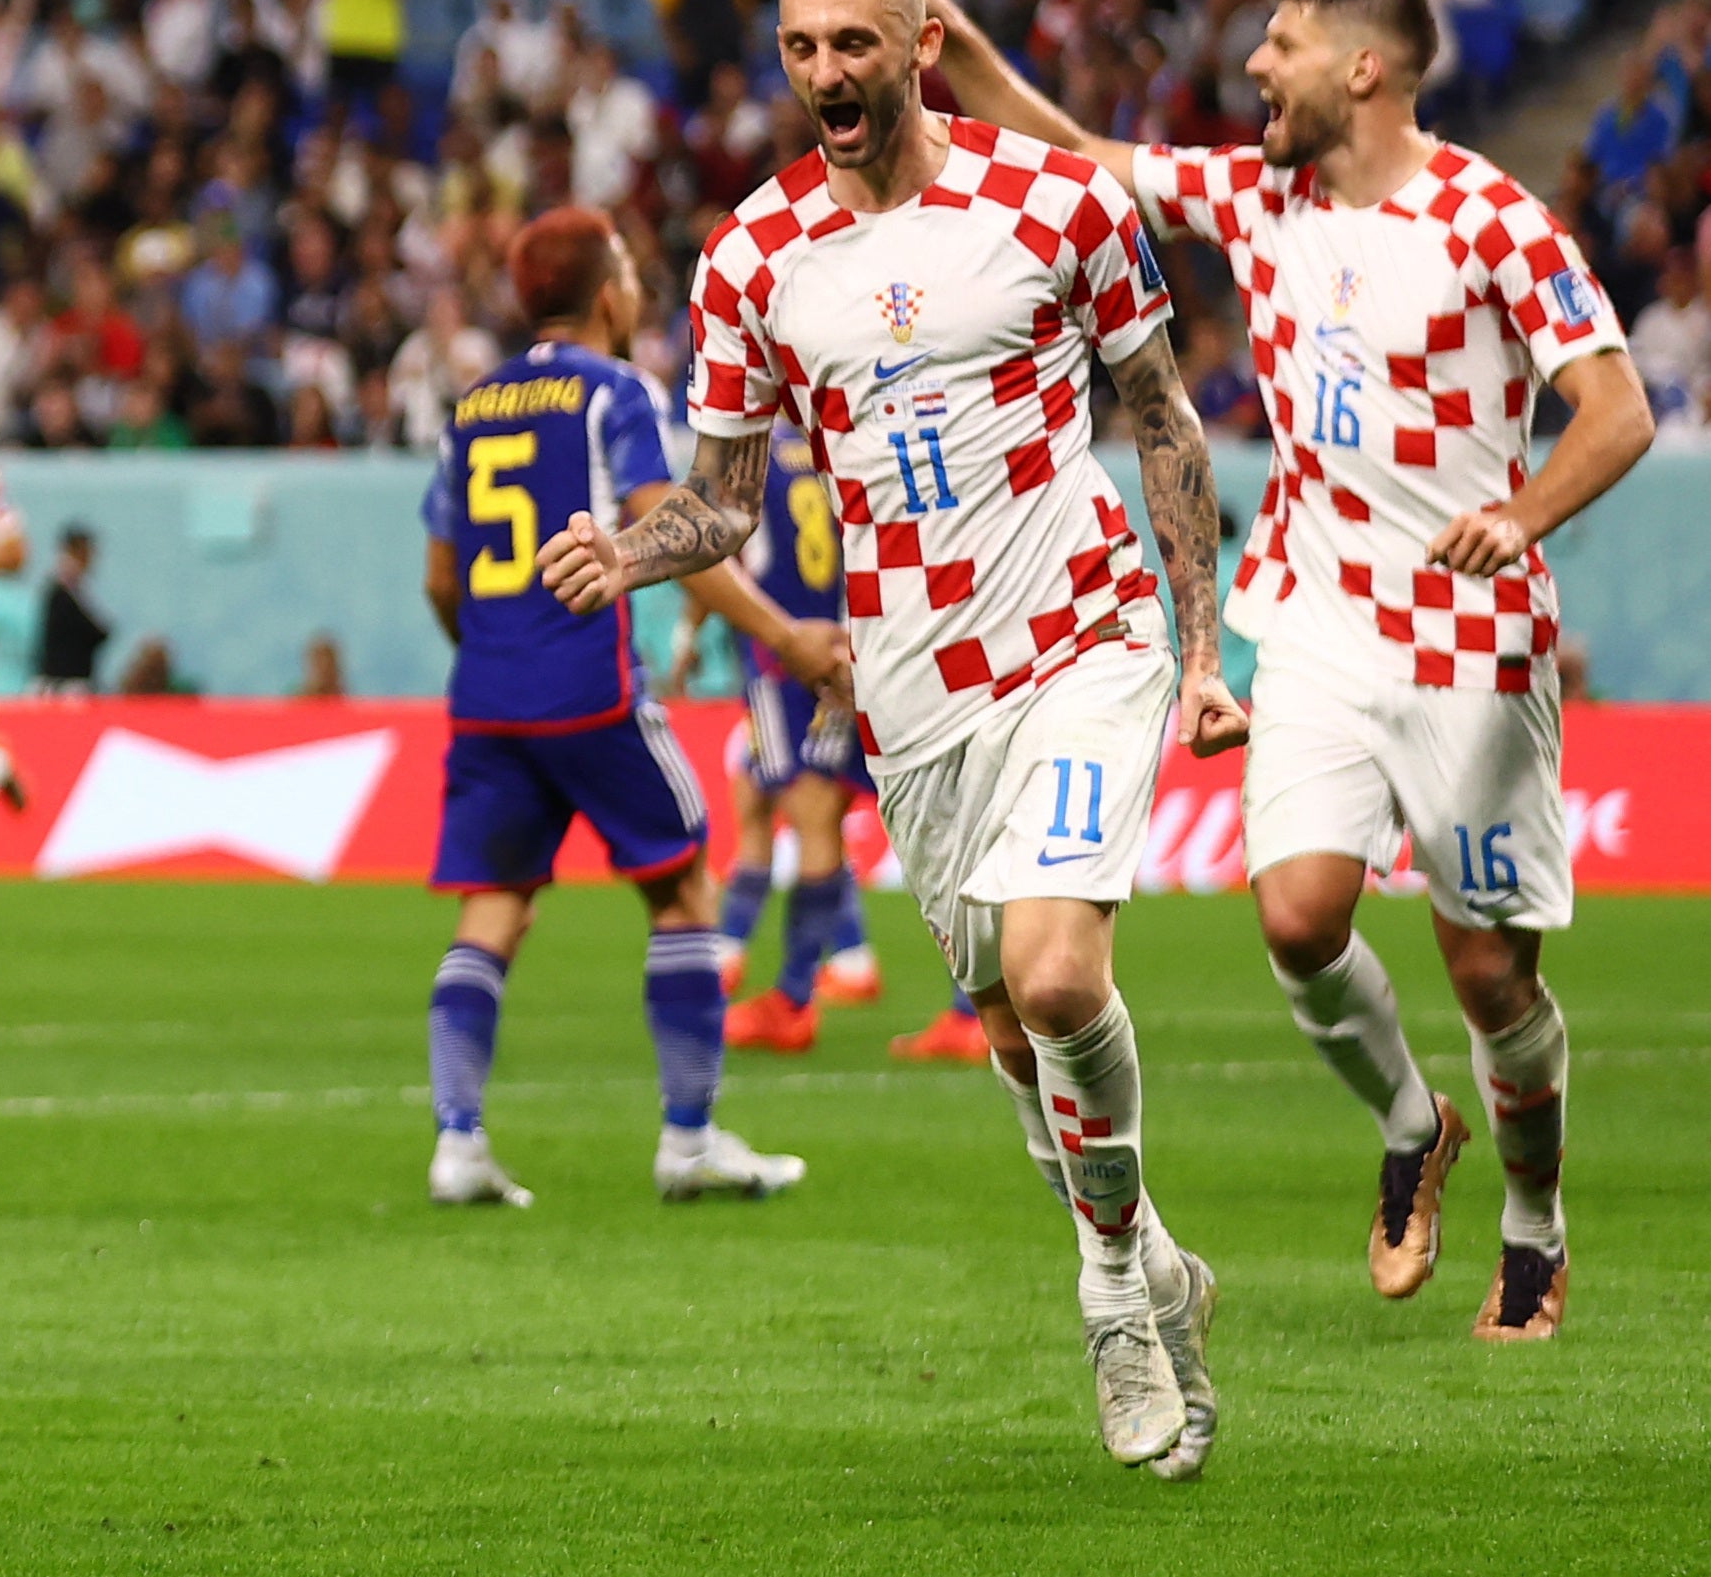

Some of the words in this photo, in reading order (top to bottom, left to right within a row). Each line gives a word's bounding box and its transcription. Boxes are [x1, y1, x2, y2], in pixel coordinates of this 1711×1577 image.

[1311, 370, 1361, 449] 16
[887, 426, 959, 514] 11
[467, 429, 539, 601] 5
[786, 474, 839, 593] 8
[1047, 758, 1103, 844] 11
[1453, 821, 1519, 892] 16
